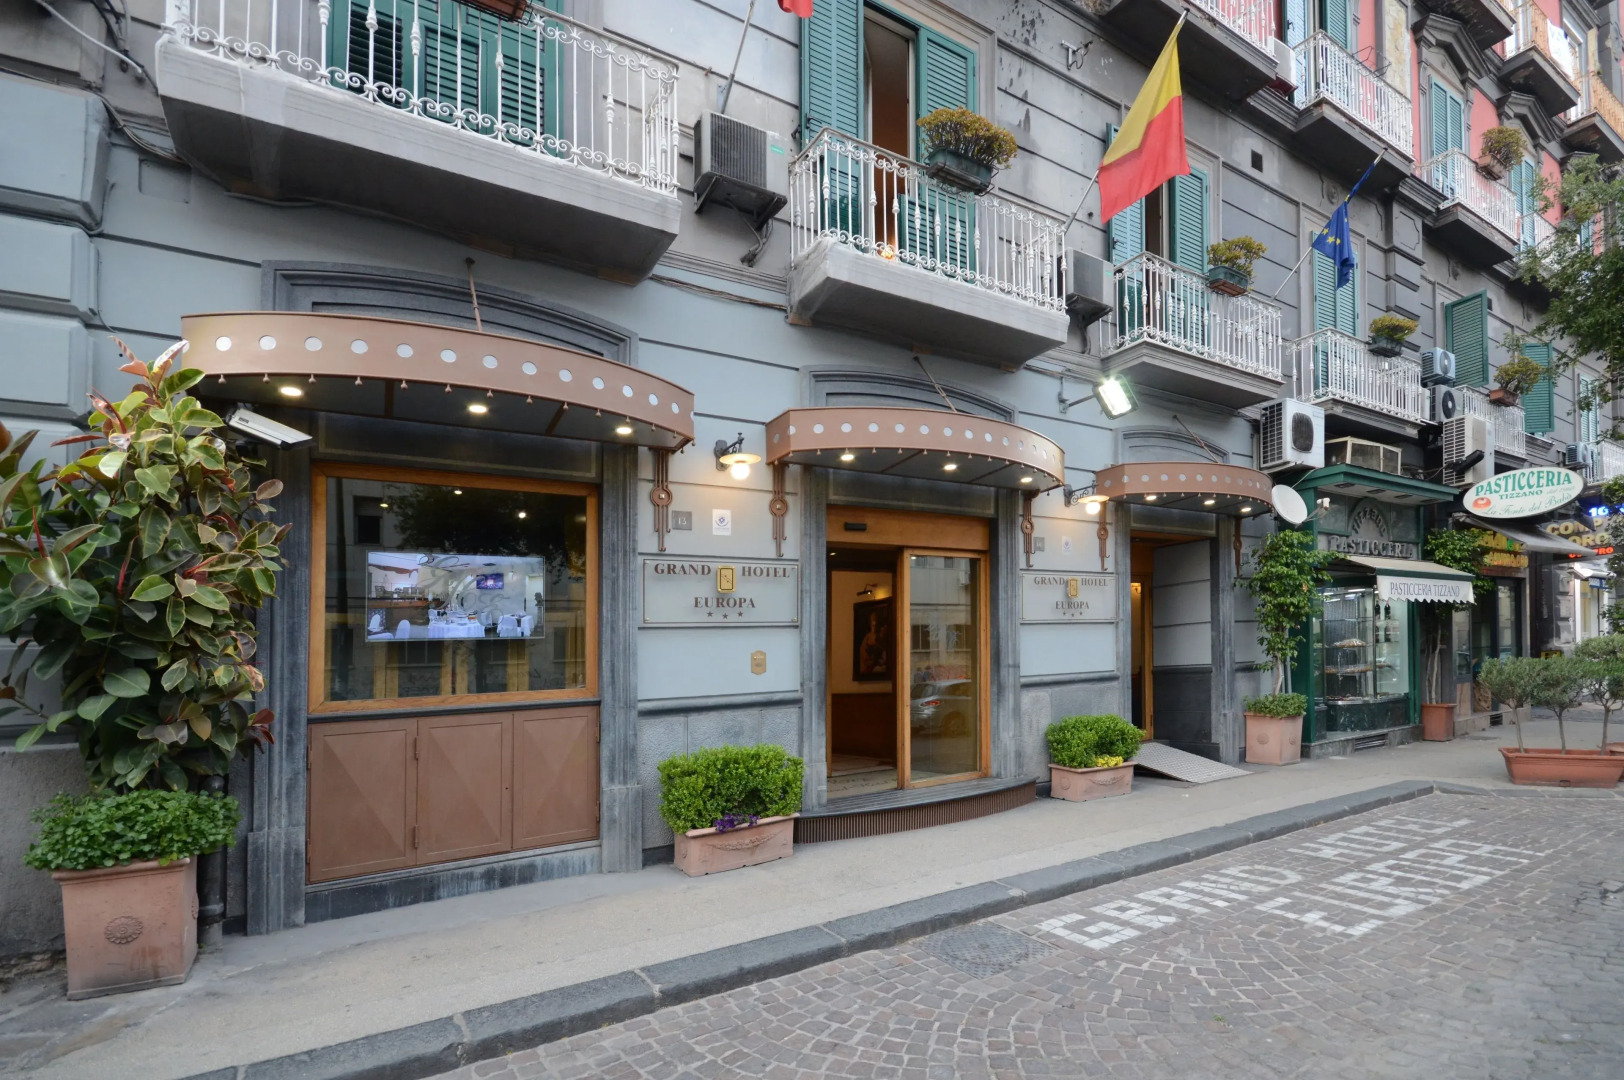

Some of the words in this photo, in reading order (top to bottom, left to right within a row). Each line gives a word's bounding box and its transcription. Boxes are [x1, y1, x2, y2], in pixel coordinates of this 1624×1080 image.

[1475, 470, 1572, 497] PASTICCERIA
[1499, 489, 1543, 500] TIZZANO
[678, 517, 687, 526] 13
[1327, 535, 1415, 558] PASTICCERIA
[654, 562, 712, 576] GRAND
[741, 565, 790, 578] HOTEL
[1033, 576, 1066, 586] GRAND
[1081, 577, 1108, 587] HOTEL
[1390, 582, 1432, 597] PASTICCERIA
[1433, 584, 1460, 597] TIZZANO
[694, 596, 756, 609] EUROPA
[1055, 600, 1090, 610] EUROPA
[1033, 864, 1303, 950] GRAND
[1286, 815, 1476, 863] HOTEL
[1253, 838, 1547, 936] EUROPA
